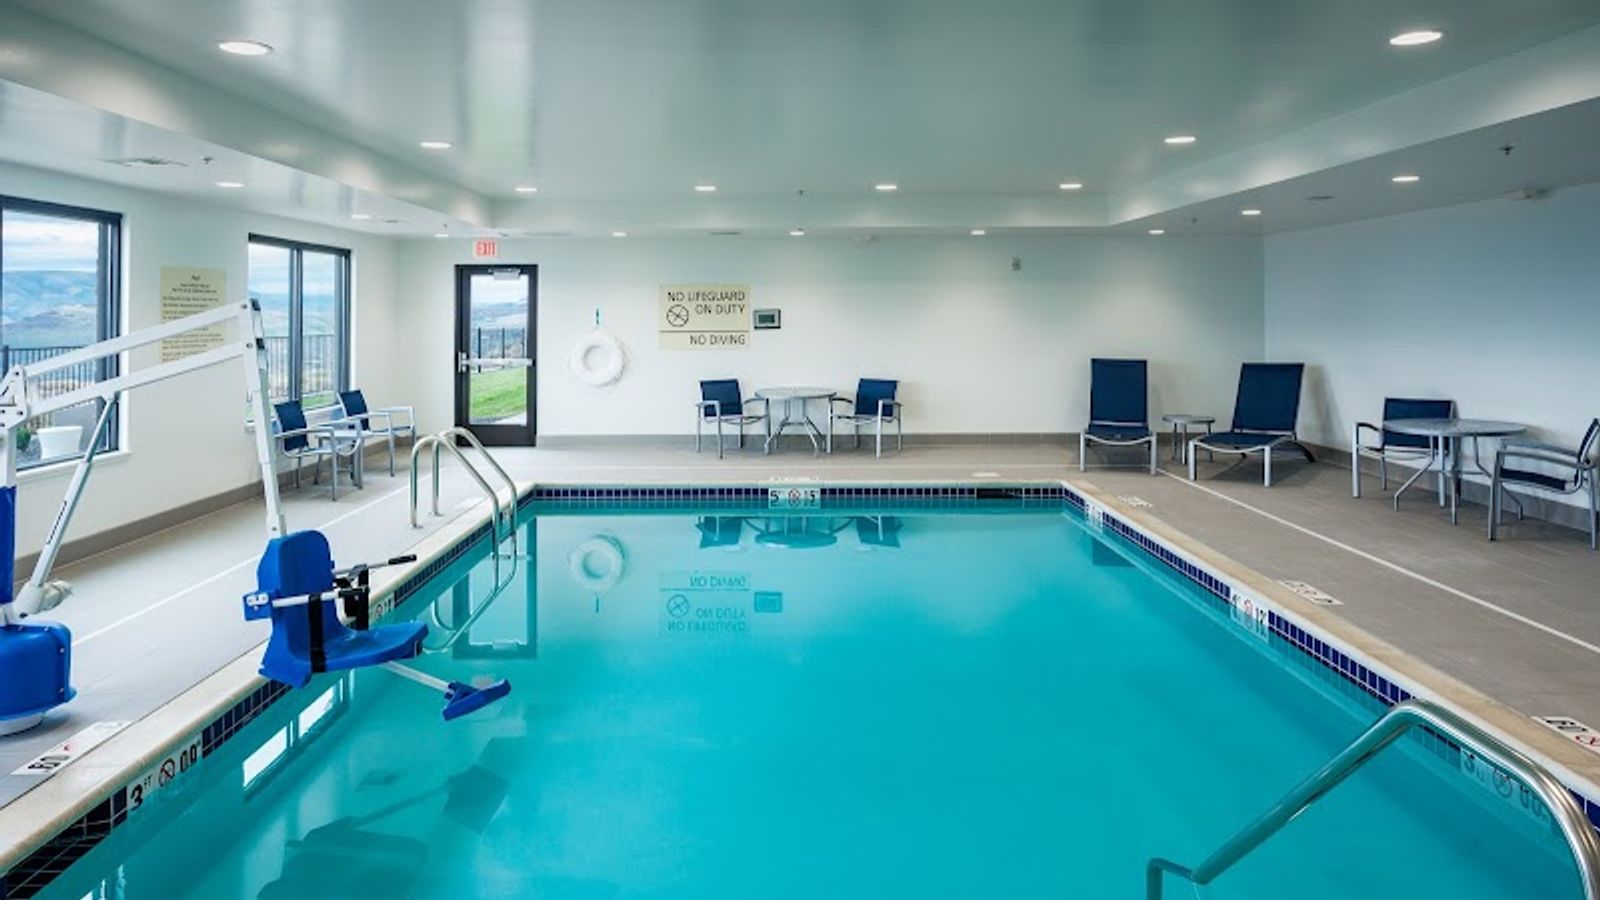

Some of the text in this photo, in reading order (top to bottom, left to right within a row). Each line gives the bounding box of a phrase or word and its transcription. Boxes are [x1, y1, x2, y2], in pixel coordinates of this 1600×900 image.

[475, 241, 496, 256] EXIT
[667, 290, 746, 302] NO LIFEGUARD
[695, 303, 746, 315] ON DUTY
[690, 334, 746, 346] NO DIVING
